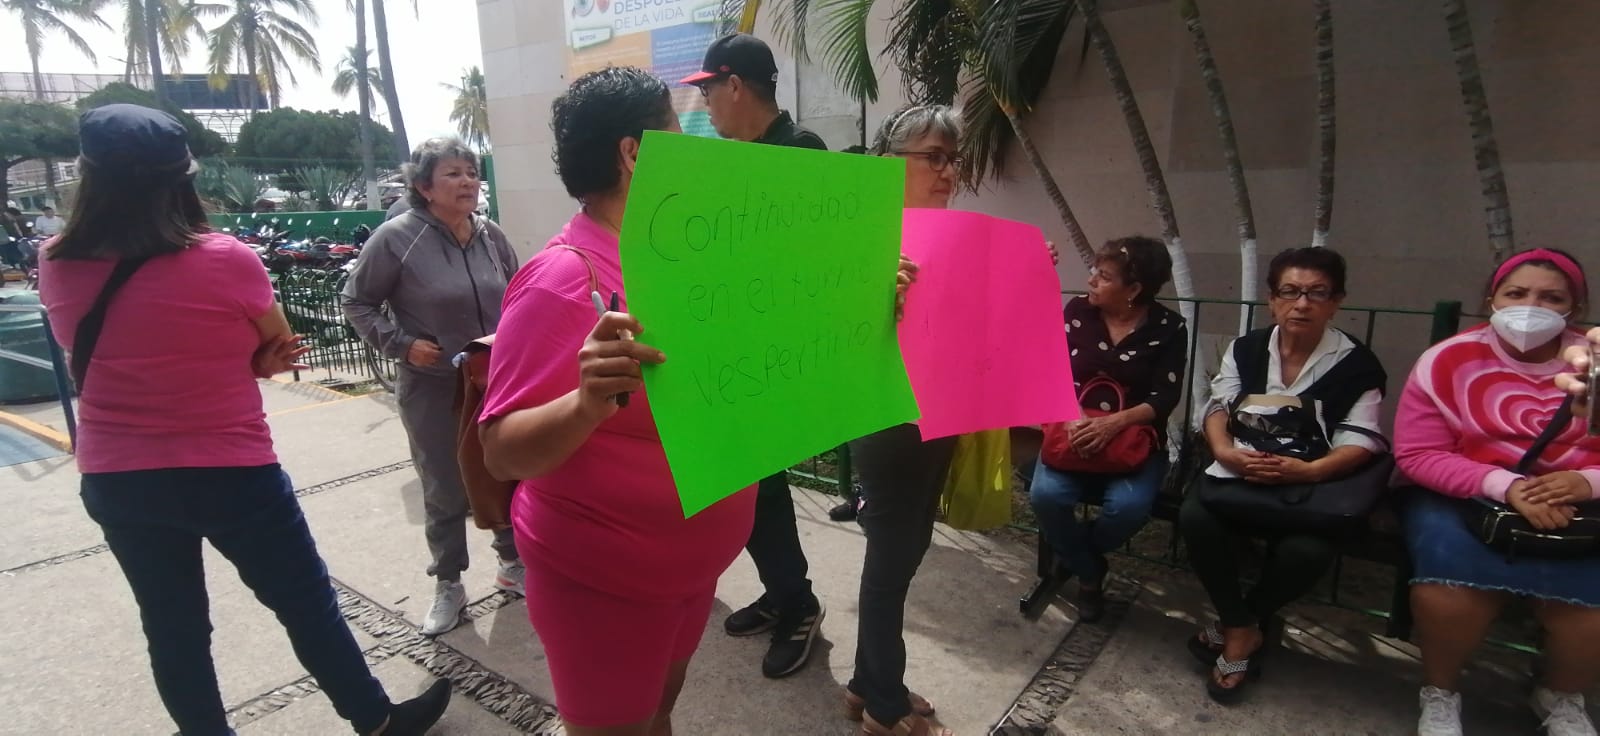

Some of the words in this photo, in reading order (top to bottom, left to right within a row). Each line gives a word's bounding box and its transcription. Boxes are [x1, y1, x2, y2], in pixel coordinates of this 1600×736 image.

[614, 0, 681, 15] DESP
[614, 17, 631, 30] DE
[634, 14, 649, 26] LA
[652, 7, 684, 23] VIDA
[649, 175, 860, 262] Continuidad
[687, 283, 732, 322] en
[746, 272, 777, 314] el
